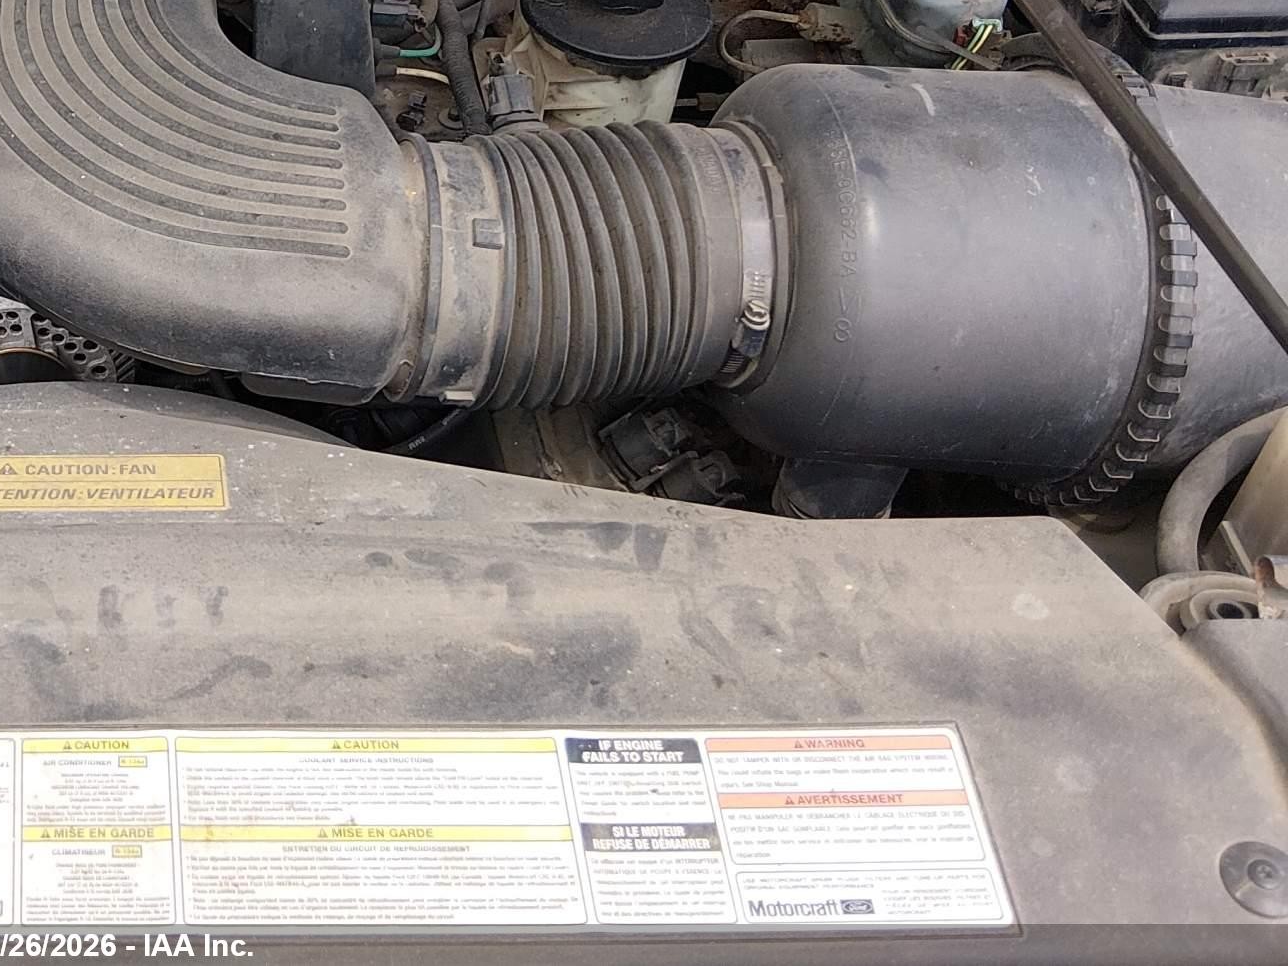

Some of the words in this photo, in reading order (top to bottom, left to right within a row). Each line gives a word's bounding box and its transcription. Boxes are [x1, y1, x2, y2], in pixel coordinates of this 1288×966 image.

[74, 740, 130, 750] CAUTION
[343, 740, 400, 750] CAUTION
[598, 740, 611, 750] IF
[614, 740, 664, 750] ENGINE
[804, 739, 865, 748] WARNING
[582, 752, 619, 762] FAILS
[623, 752, 641, 762] TO
[643, 751, 684, 762] START
[797, 793, 904, 805] AVERTISSEMENT
[53, 828, 85, 838] MISE
[89, 828, 106, 838] EN
[112, 827, 155, 838] GARDE
[331, 828, 364, 838] MISE
[367, 828, 385, 838] EN
[389, 828, 434, 838] GARDE
[612, 826, 624, 837] SI
[626, 826, 640, 837] LE
[641, 826, 685, 837] MOTEUR
[592, 839, 633, 850] REFUSE
[635, 839, 649, 850] DE
[748, 899, 840, 917] Motorcraft
